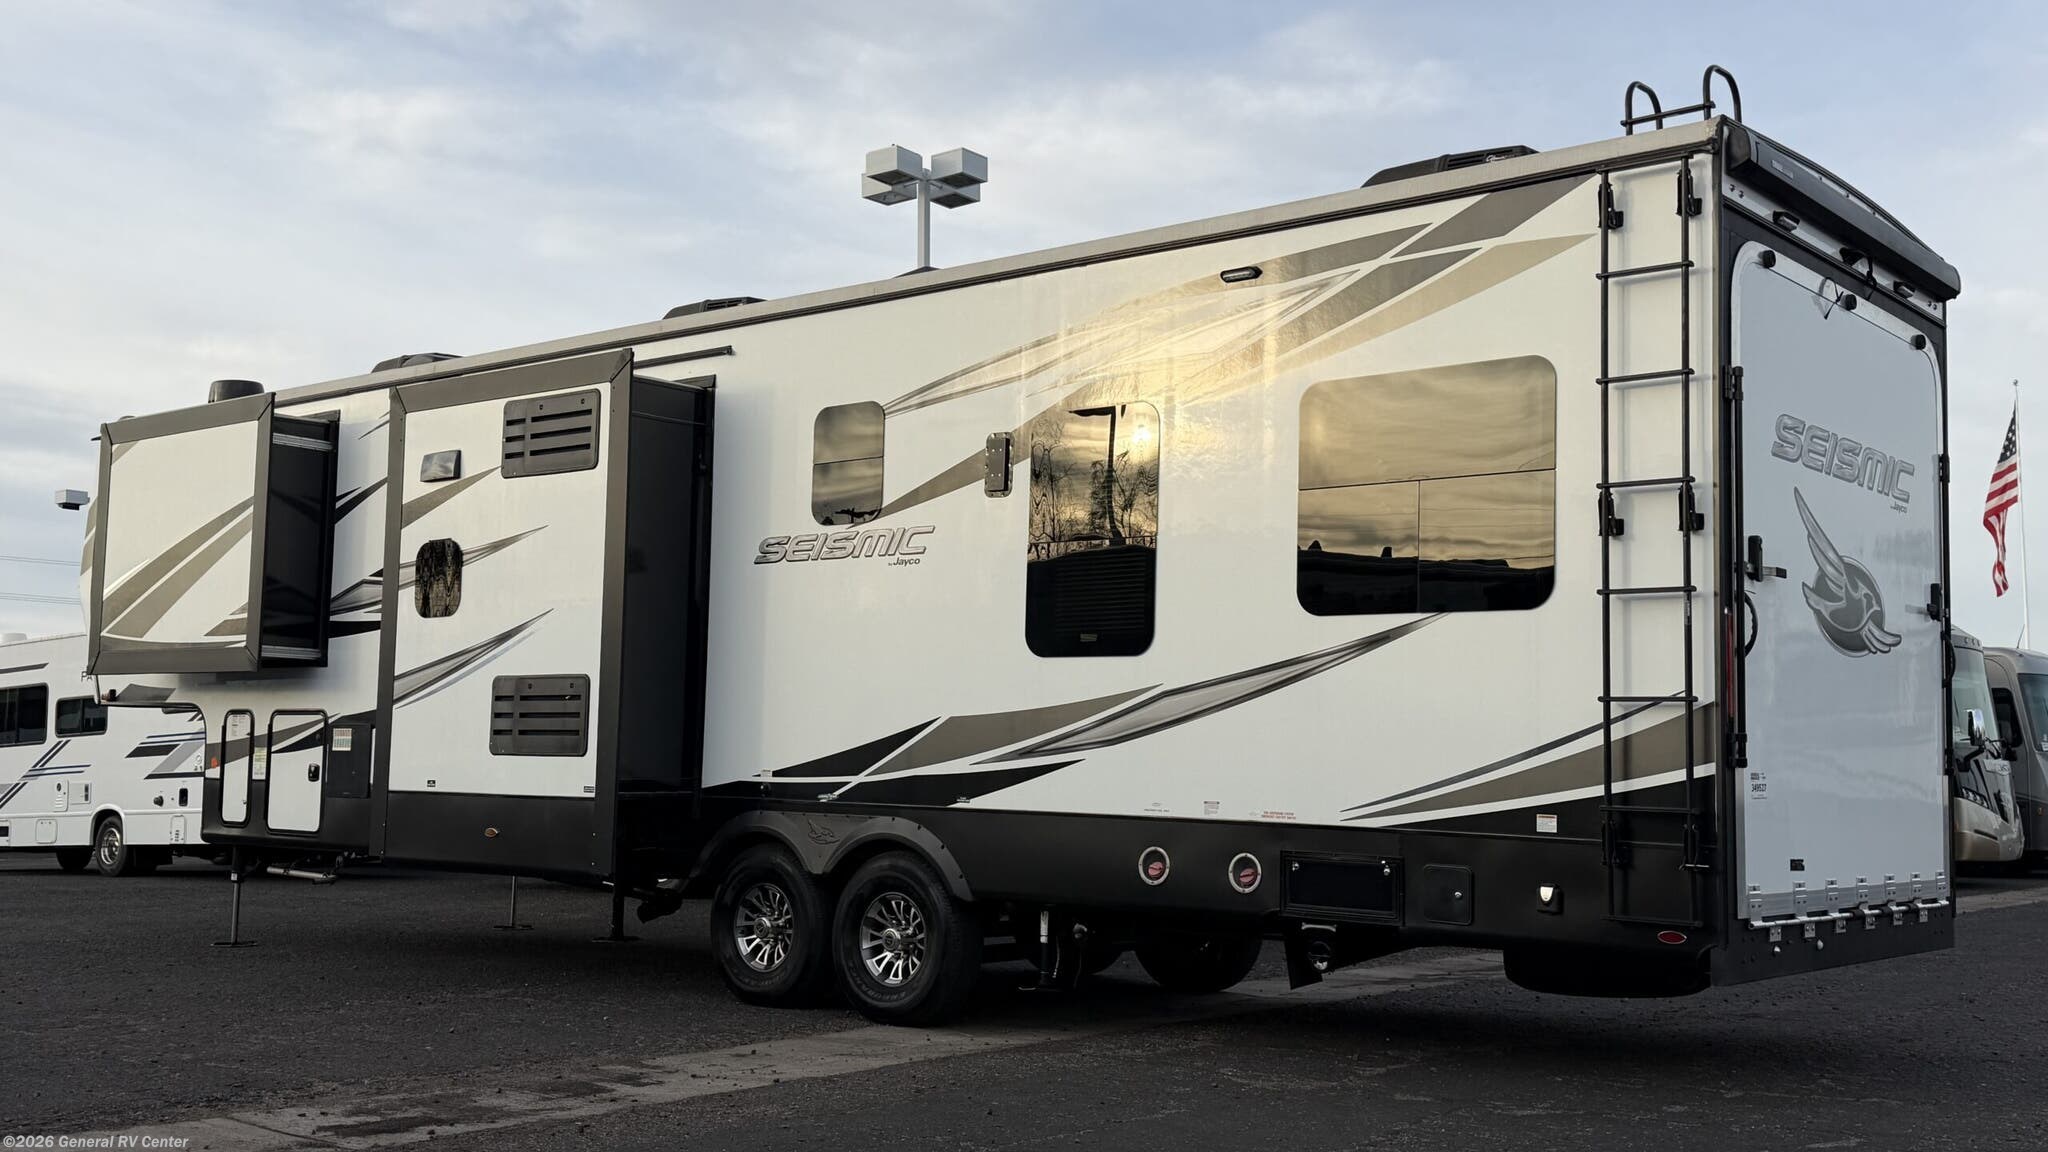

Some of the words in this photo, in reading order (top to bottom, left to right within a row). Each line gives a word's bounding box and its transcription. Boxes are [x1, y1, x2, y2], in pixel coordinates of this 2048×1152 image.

[1771, 413, 1916, 504] SEISMIC
[754, 525, 936, 565] SEISMIC
[893, 557, 920, 567] Jayco
